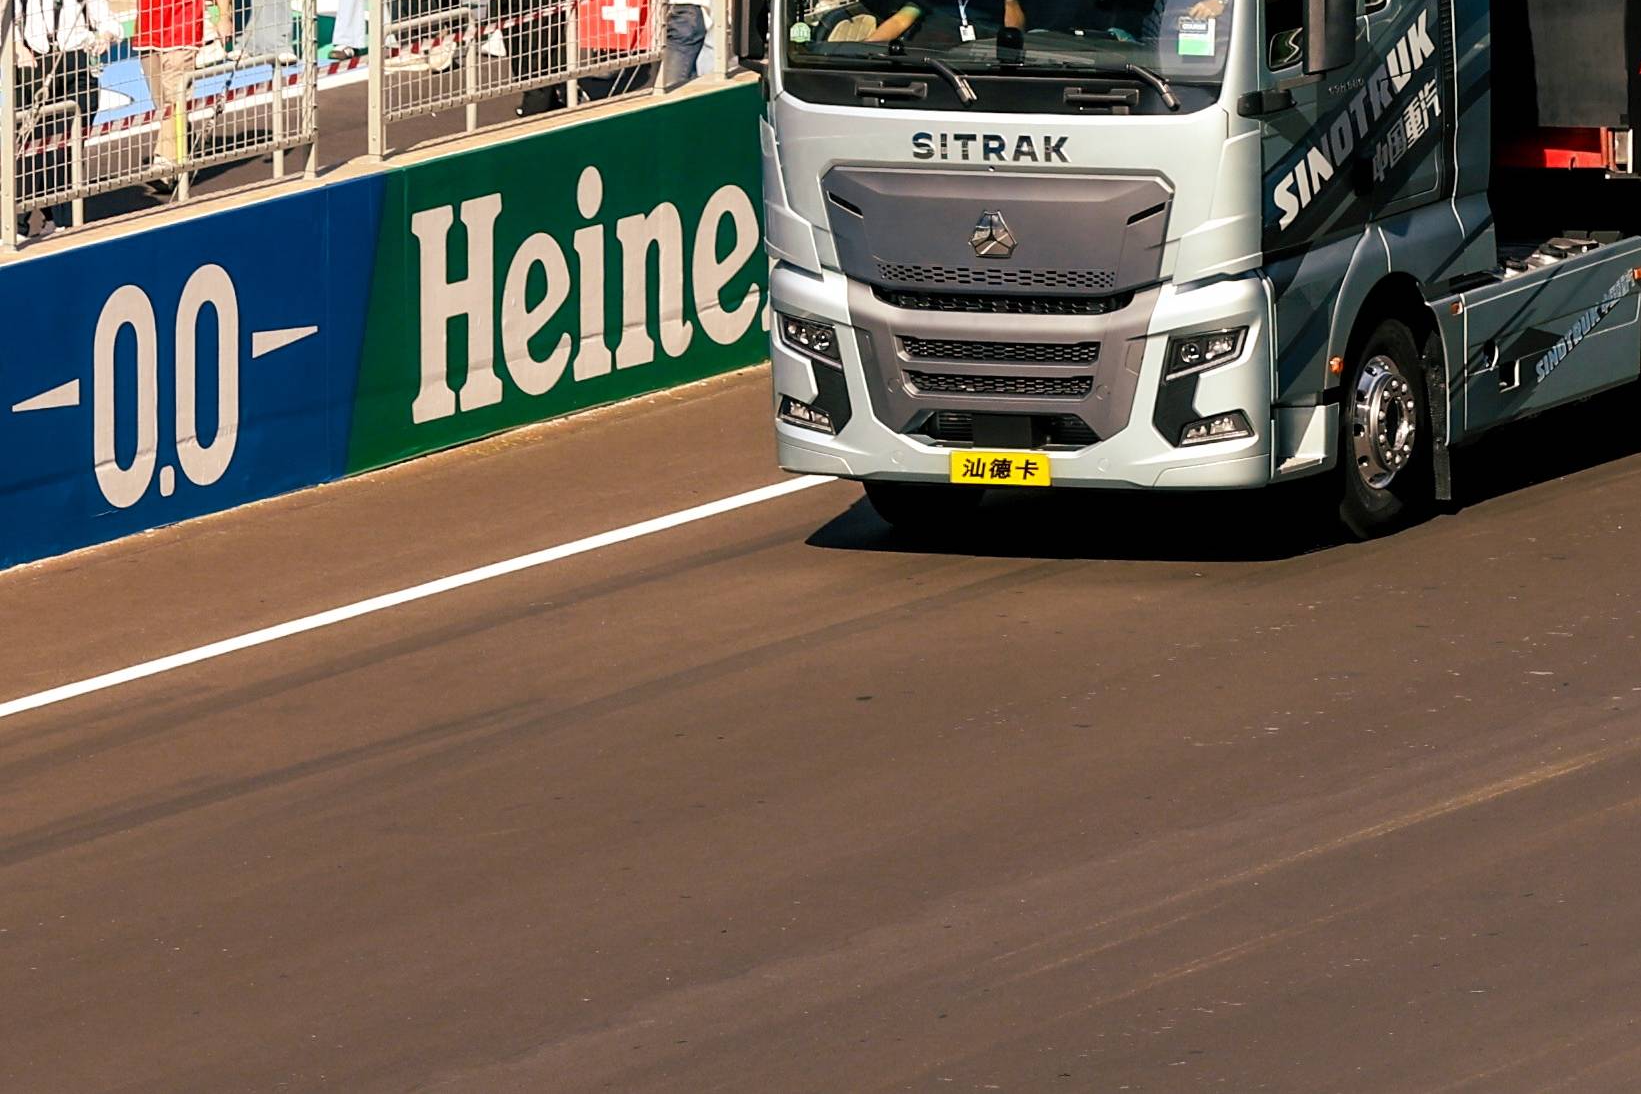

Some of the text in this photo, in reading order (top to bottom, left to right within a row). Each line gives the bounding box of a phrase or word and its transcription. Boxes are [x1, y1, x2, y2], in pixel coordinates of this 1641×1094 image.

[912, 131, 1071, 164] SITRAK
[1273, 8, 1436, 232] SINOTRUK
[1372, 77, 1442, 184] 中国重汽
[411, 165, 770, 425] Heine
[1535, 305, 1601, 384] SINOTRUK
[93, 263, 240, 509] 0.0
[962, 457, 1040, 481] 汕德卡
